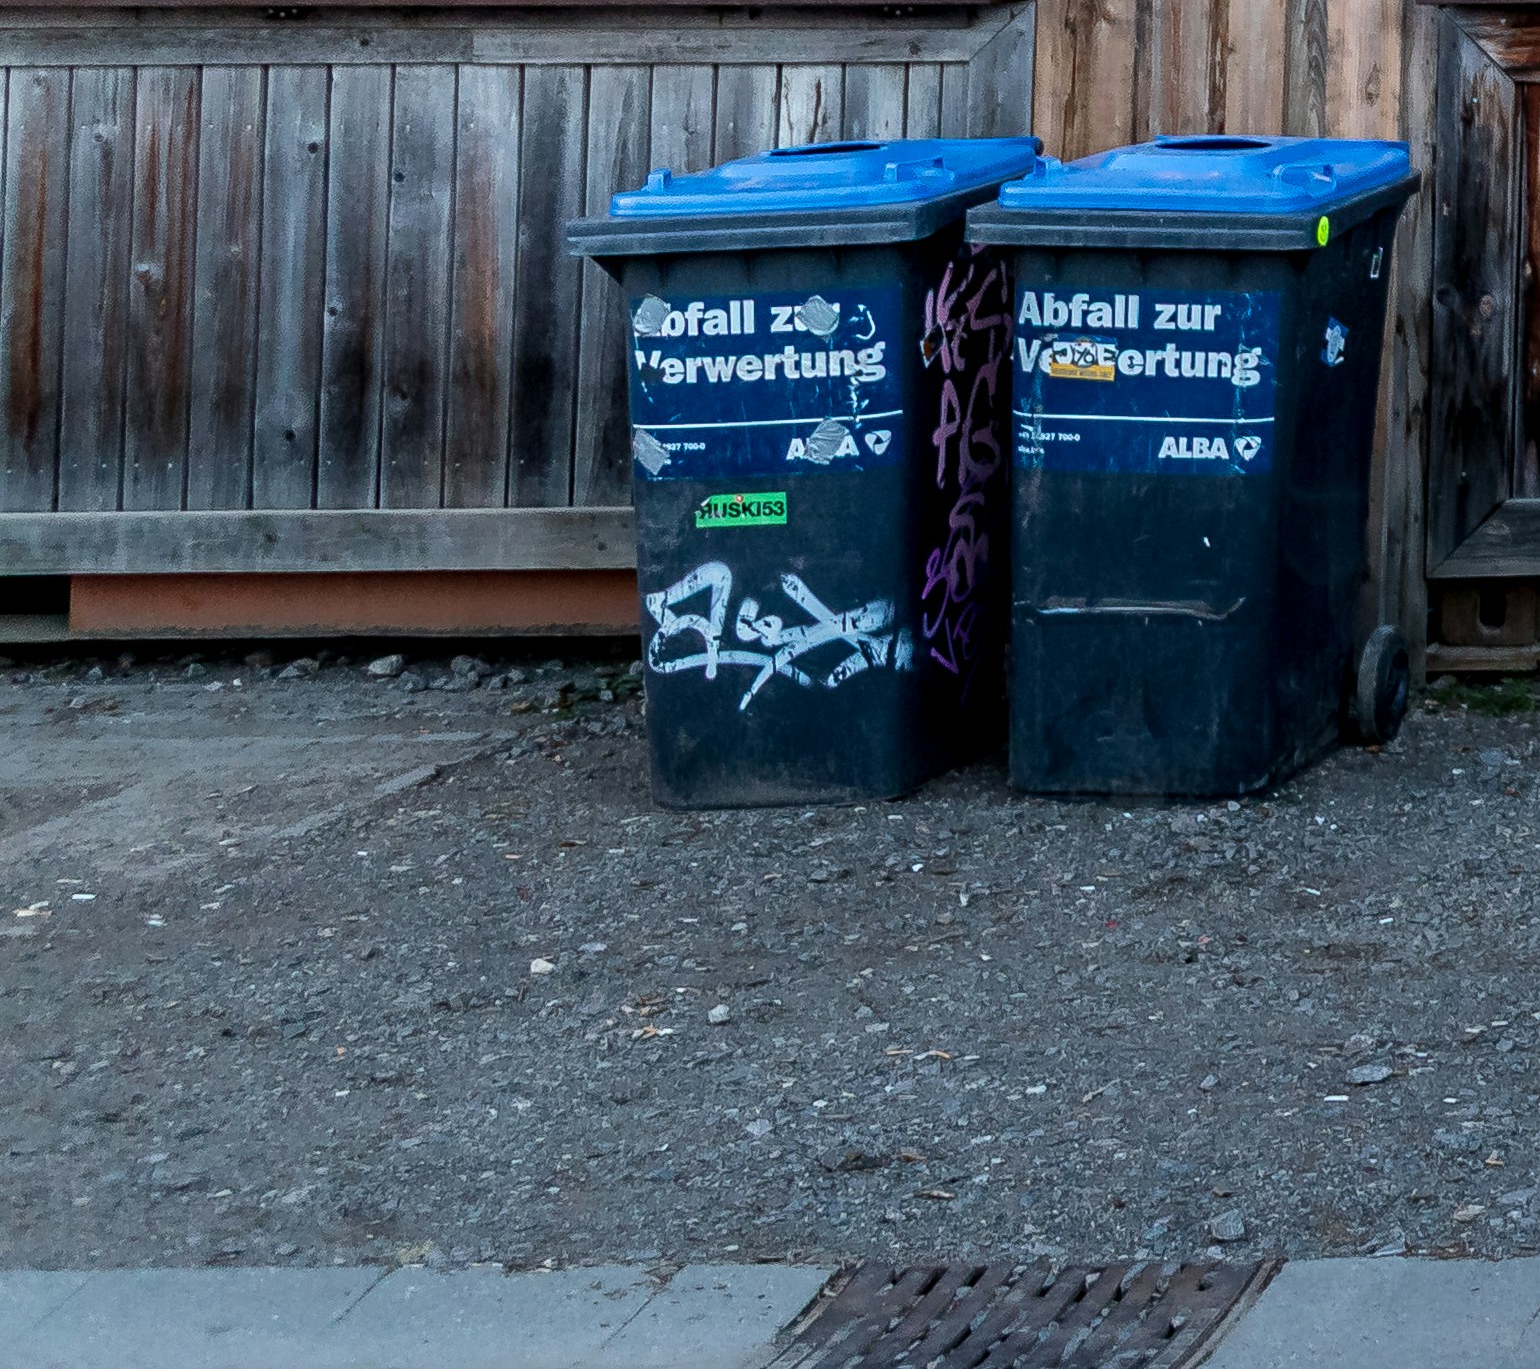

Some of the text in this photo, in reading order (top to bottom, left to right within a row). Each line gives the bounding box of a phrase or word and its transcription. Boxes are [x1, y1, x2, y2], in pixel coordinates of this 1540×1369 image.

[633, 298, 755, 337] bfall
[1018, 291, 1221, 331] Abfall zur
[1157, 436, 1229, 460] ALBA
